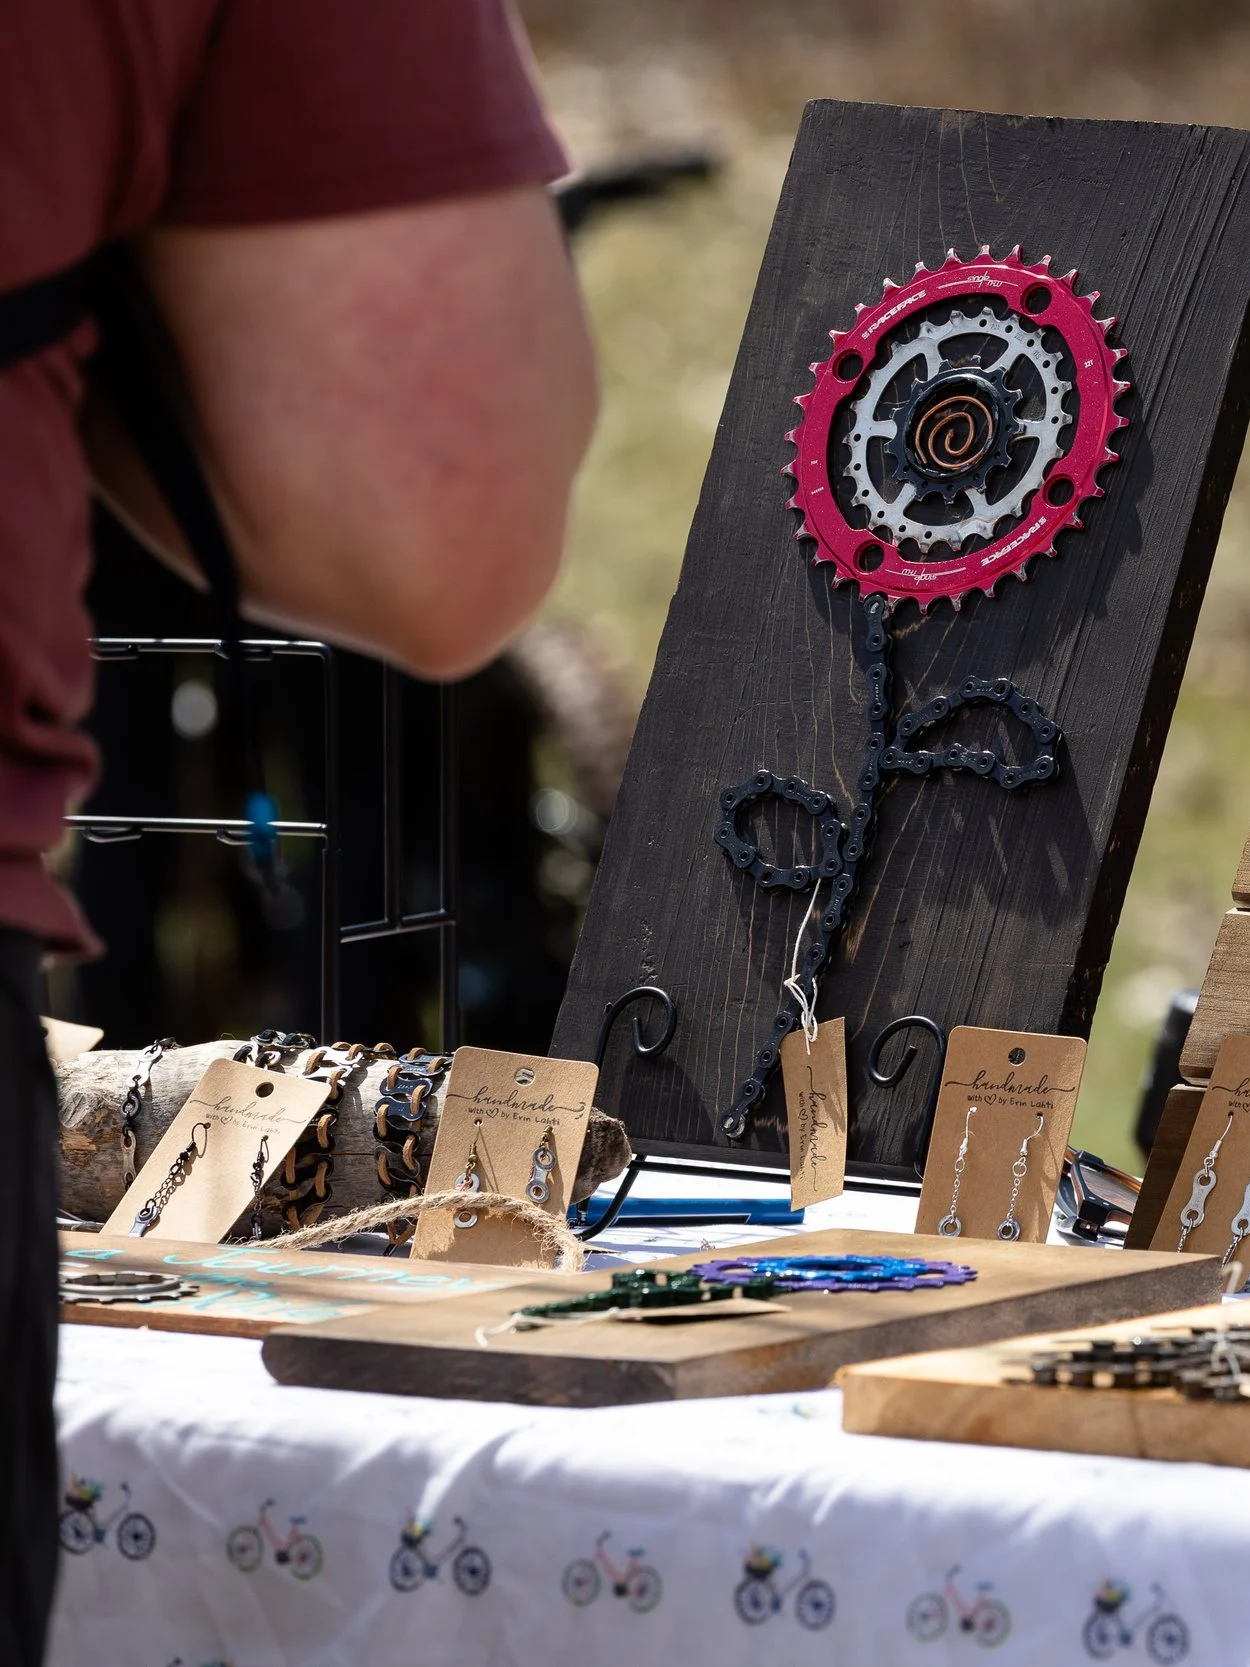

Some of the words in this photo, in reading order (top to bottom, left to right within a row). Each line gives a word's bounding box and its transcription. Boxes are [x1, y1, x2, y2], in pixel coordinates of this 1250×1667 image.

[868, 289, 927, 334] RACEFACE
[981, 522, 1041, 567] RACEFACE
[945, 1069, 1076, 1095] handmade
[189, 1095, 307, 1124] handmade
[445, 1086, 586, 1112] handmade
[967, 1094, 983, 1102] with
[998, 1097, 1006, 1106] by
[1010, 1098, 1027, 1106] Erin
[1031, 1101, 1054, 1109] Lahti
[1228, 1100, 1242, 1108] with
[205, 1112, 220, 1120] with
[513, 1113, 531, 1121] Erin
[535, 1116, 560, 1126] Lahti
[800, 1123, 806, 1132] by
[806, 1065, 828, 1192] handmade
[163, 1246, 510, 1291] Journey
